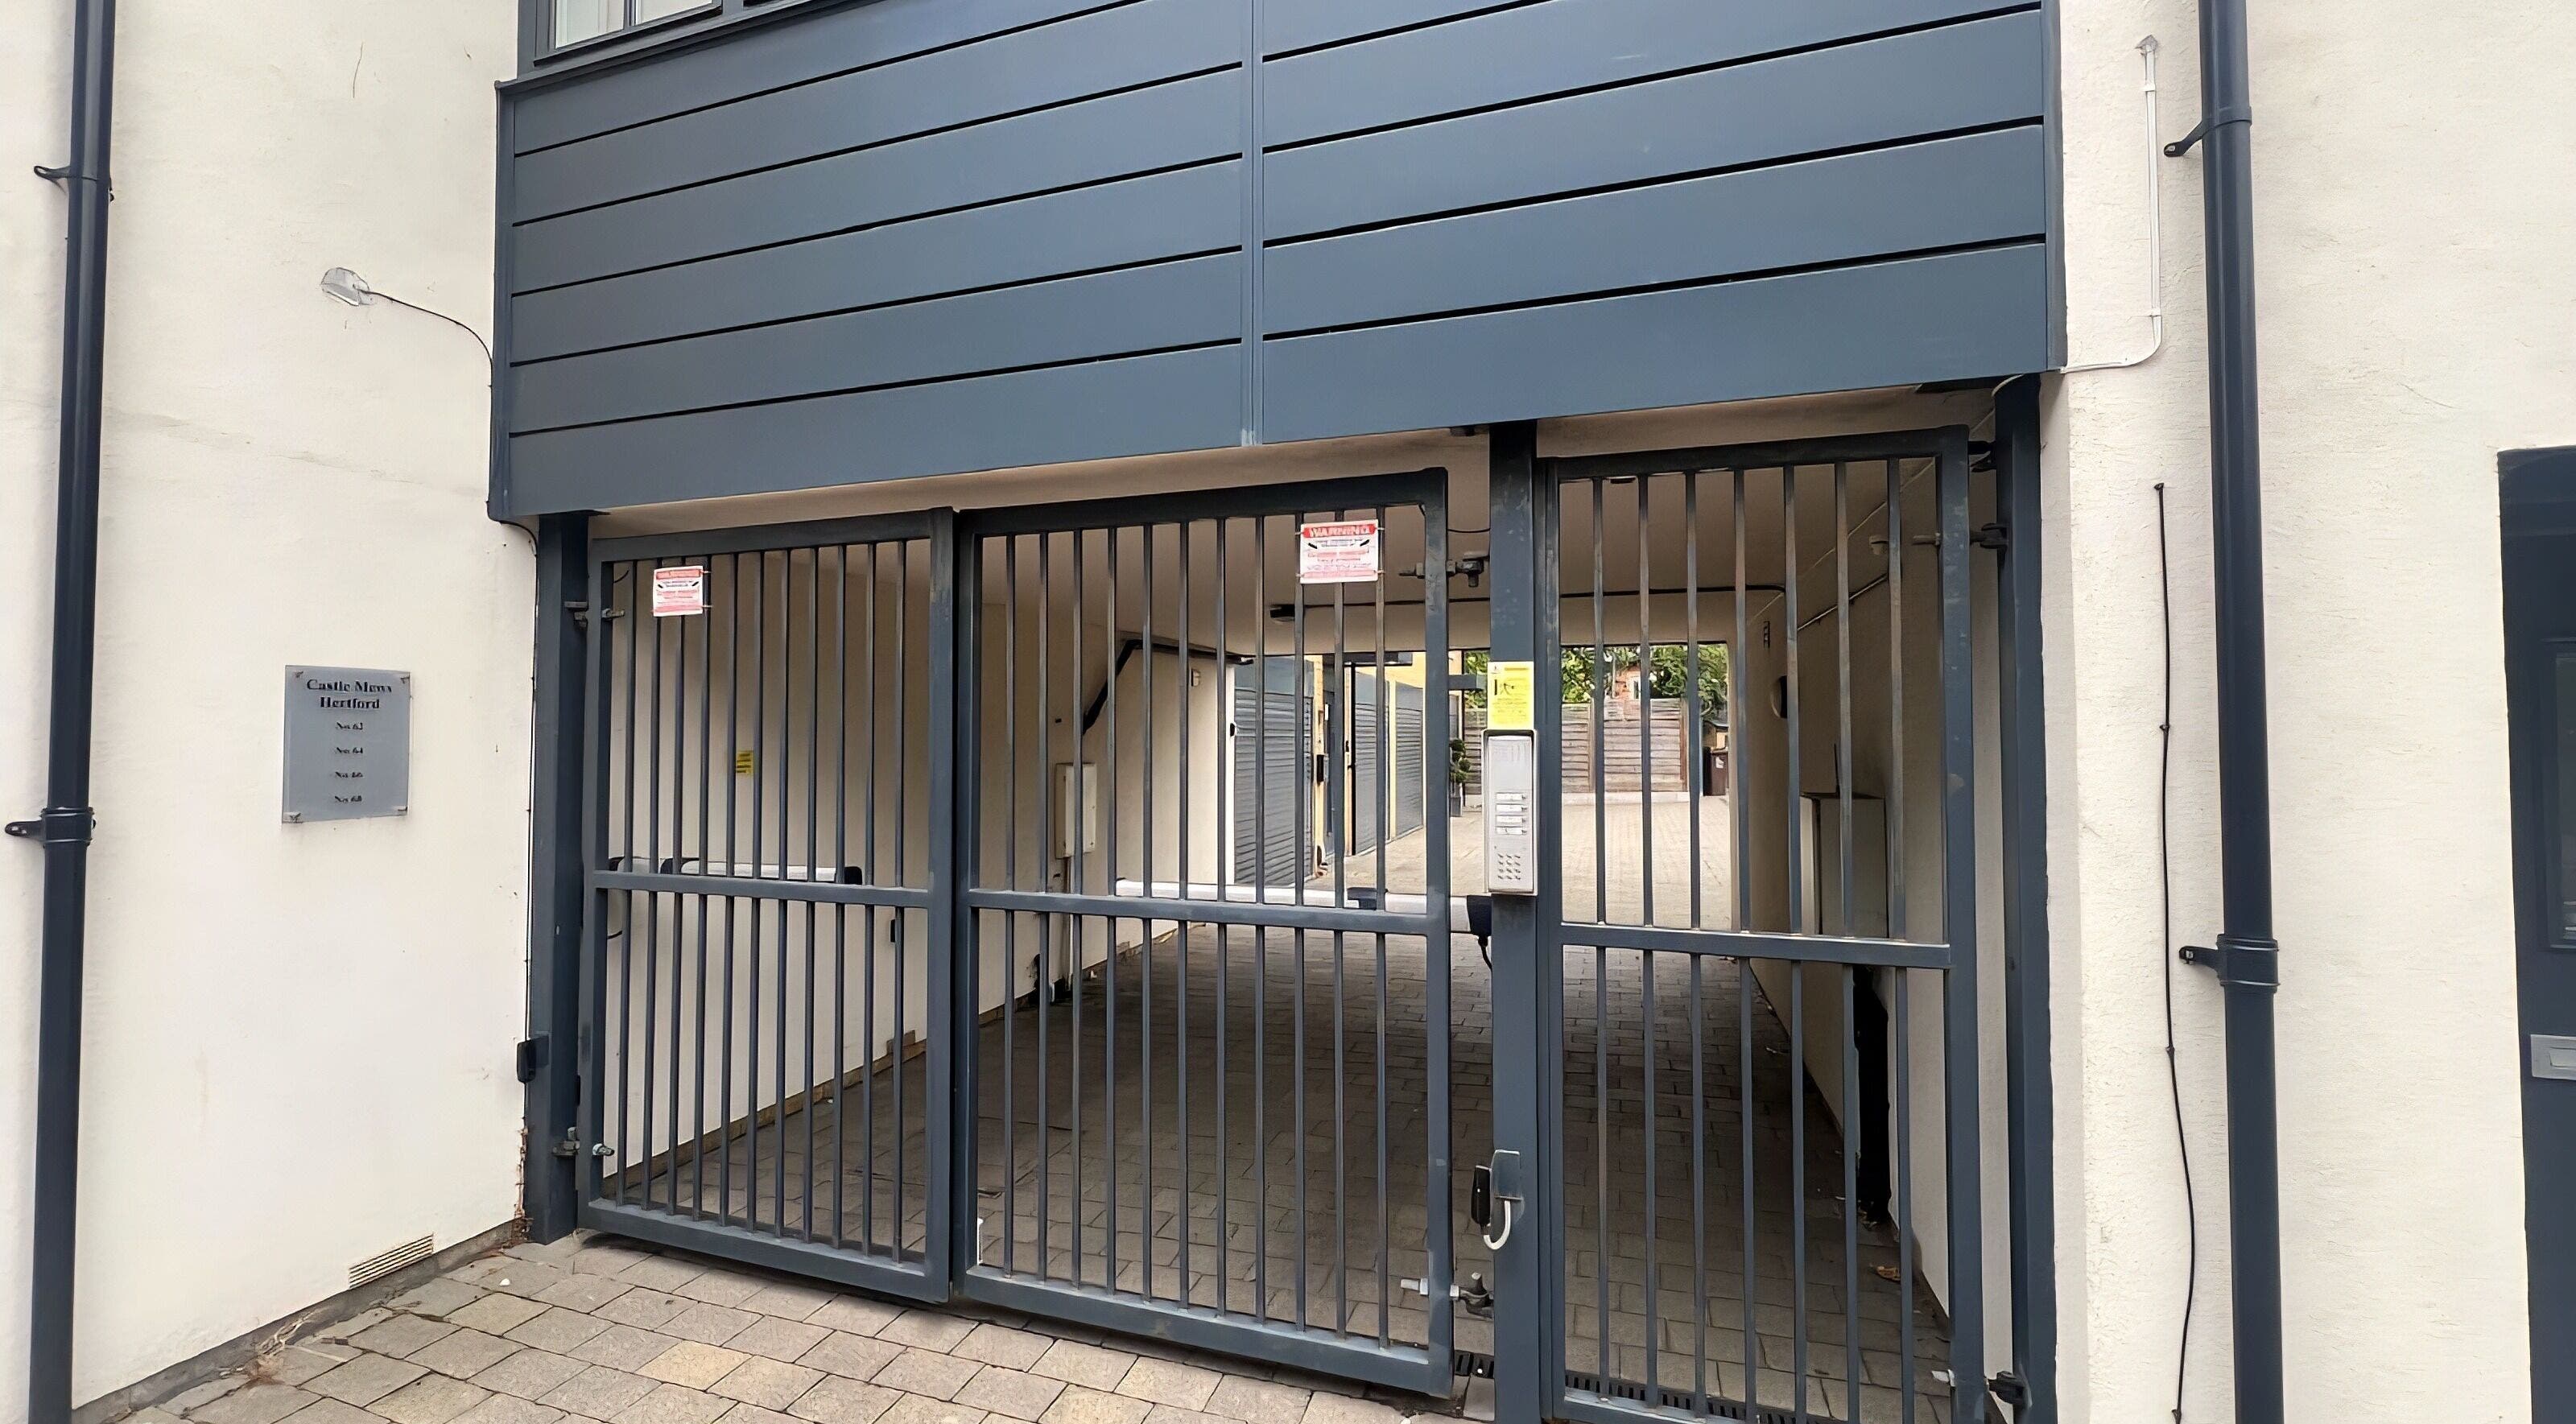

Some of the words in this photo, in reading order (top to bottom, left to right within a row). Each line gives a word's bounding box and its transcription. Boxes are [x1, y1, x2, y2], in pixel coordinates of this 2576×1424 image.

[1308, 525, 1370, 538] WARNING
[307, 679, 350, 692] Castle
[355, 681, 392, 693] Mews
[320, 696, 380, 709] Hertford
